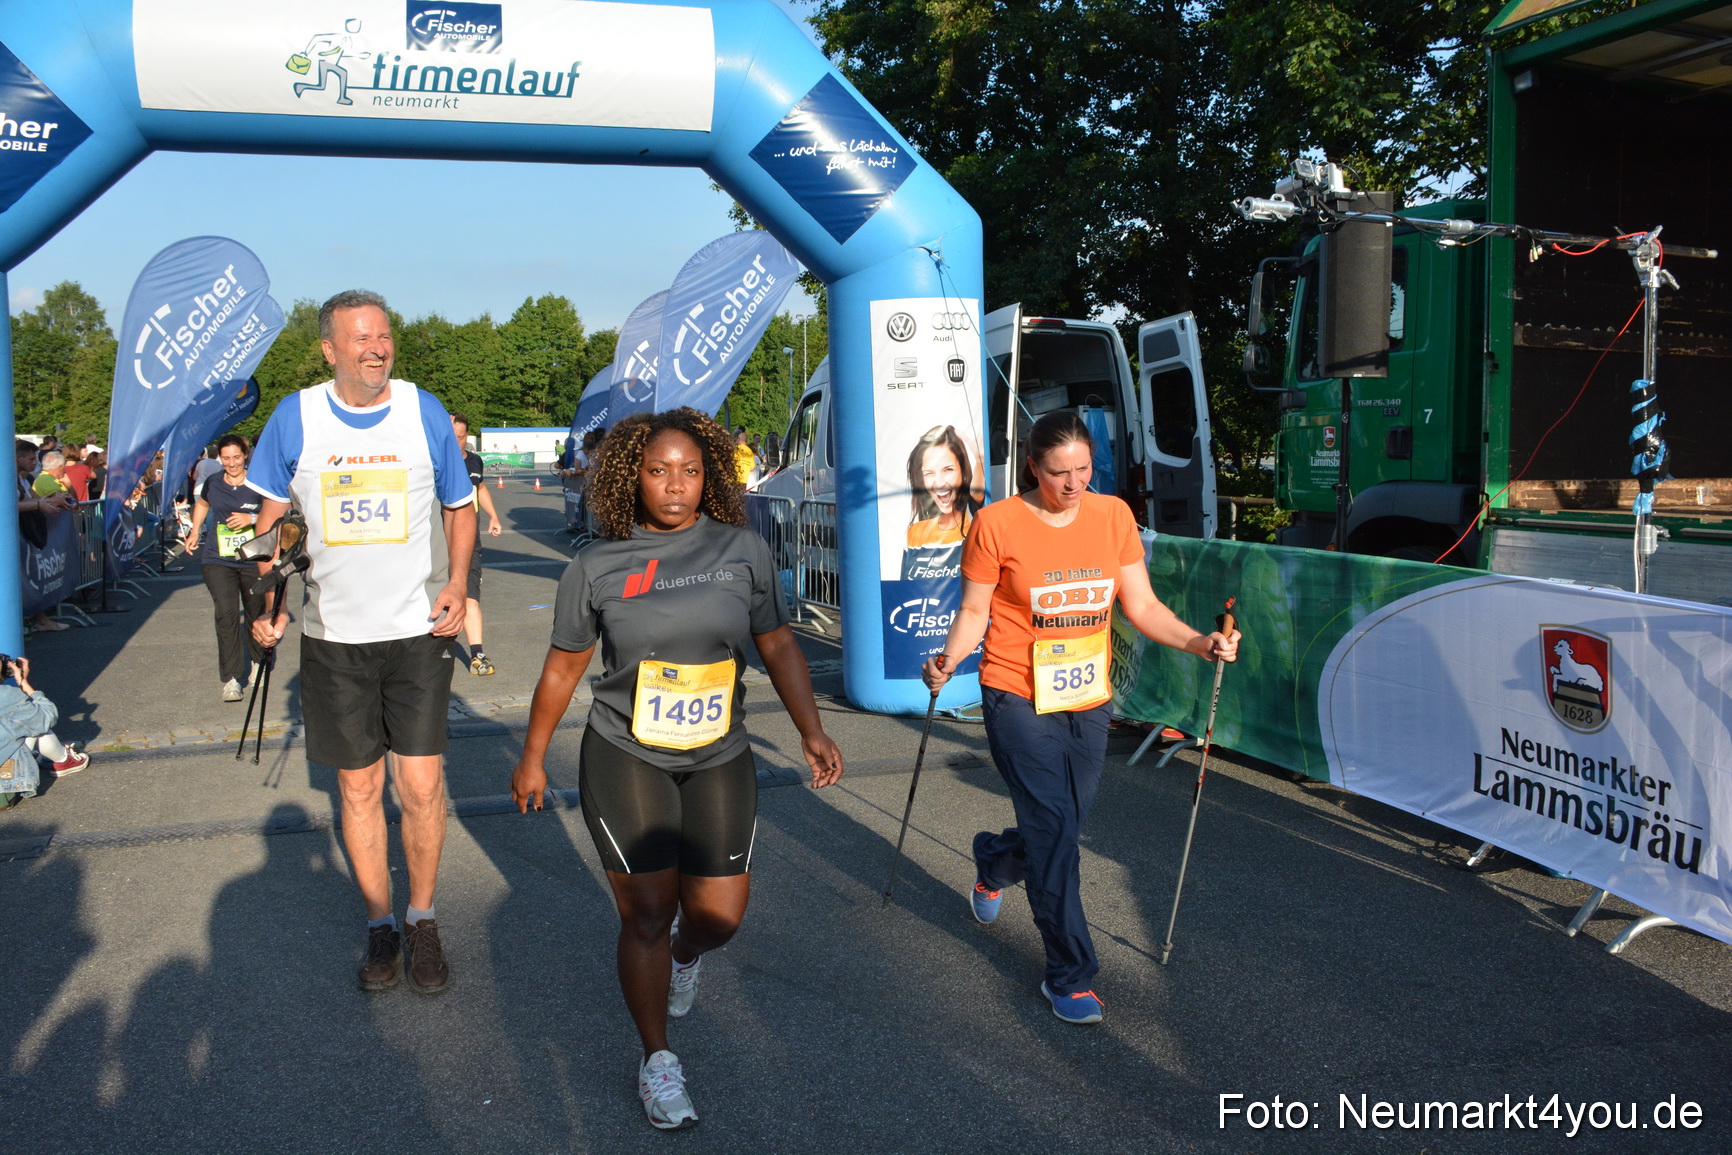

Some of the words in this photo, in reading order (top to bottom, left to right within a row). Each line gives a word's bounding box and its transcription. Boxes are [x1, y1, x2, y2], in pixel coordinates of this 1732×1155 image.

[427, 18, 497, 34] Fischer
[373, 53, 583, 98] firmenlauf
[372, 94, 460, 110] neumarkt
[789, 140, 818, 157] und
[867, 156, 897, 169] mit!
[154, 263, 238, 371] Fischer
[691, 253, 767, 367] Fischer
[718, 272, 776, 364] AUTOMOBILE
[183, 285, 247, 371] AUTOMOBILE
[220, 322, 268, 390] AUTOMOBILE
[949, 363, 964, 378] FIAT
[886, 381, 926, 390] SEAT
[1424, 408, 1434, 424] 7
[346, 455, 402, 465] KLEBL
[339, 499, 391, 524] 554
[655, 568, 734, 591] duerrer.de
[1044, 570, 1063, 584] 30
[1067, 567, 1102, 581] Jahre
[1037, 586, 1109, 609] OBI
[1031, 609, 1109, 630] Neumarkt
[1052, 662, 1095, 692] 583
[647, 694, 724, 726] 1495
[1562, 704, 1594, 724] 1628
[1500, 726, 1672, 807] Neumarkter
[1473, 752, 1703, 876] Lammsbräu
